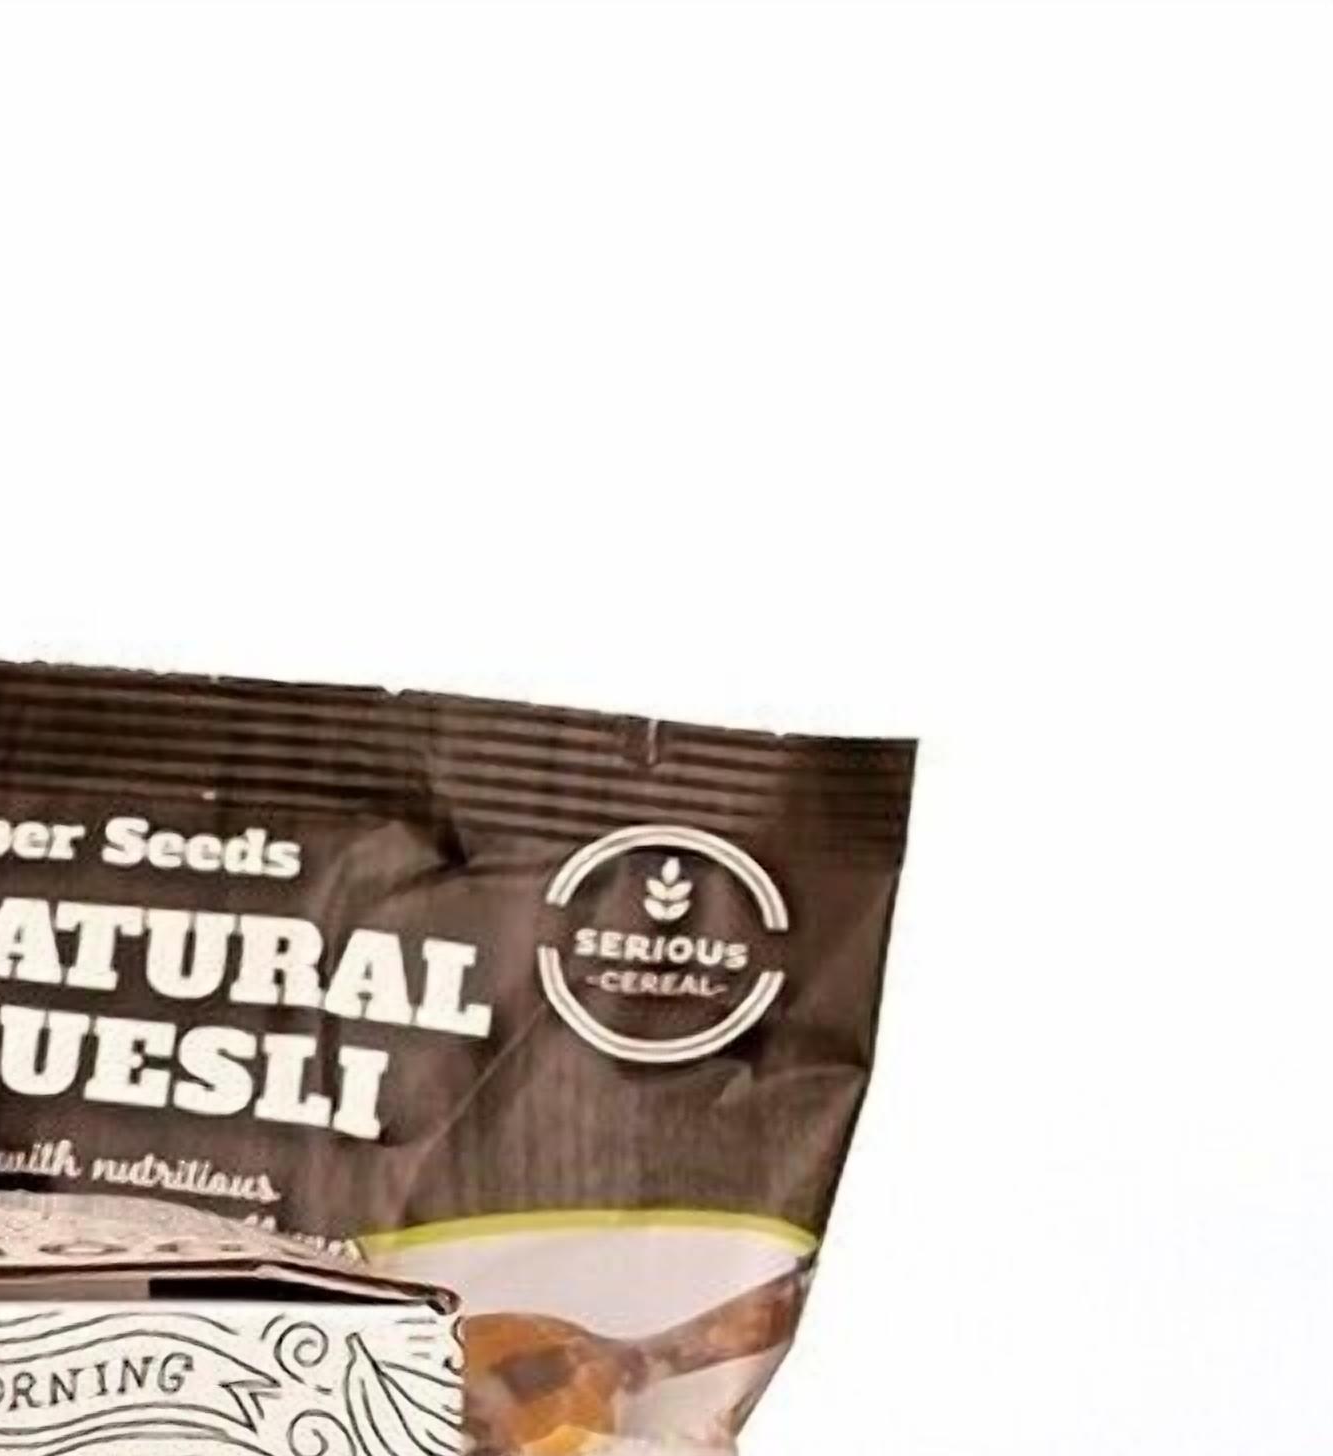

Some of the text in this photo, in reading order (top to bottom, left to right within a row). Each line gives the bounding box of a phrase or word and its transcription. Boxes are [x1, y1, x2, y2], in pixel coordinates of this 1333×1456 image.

[102, 816, 302, 879] Seeds
[575, 928, 748, 970] SERIOUS
[92, 1152, 282, 1204] nutritious
